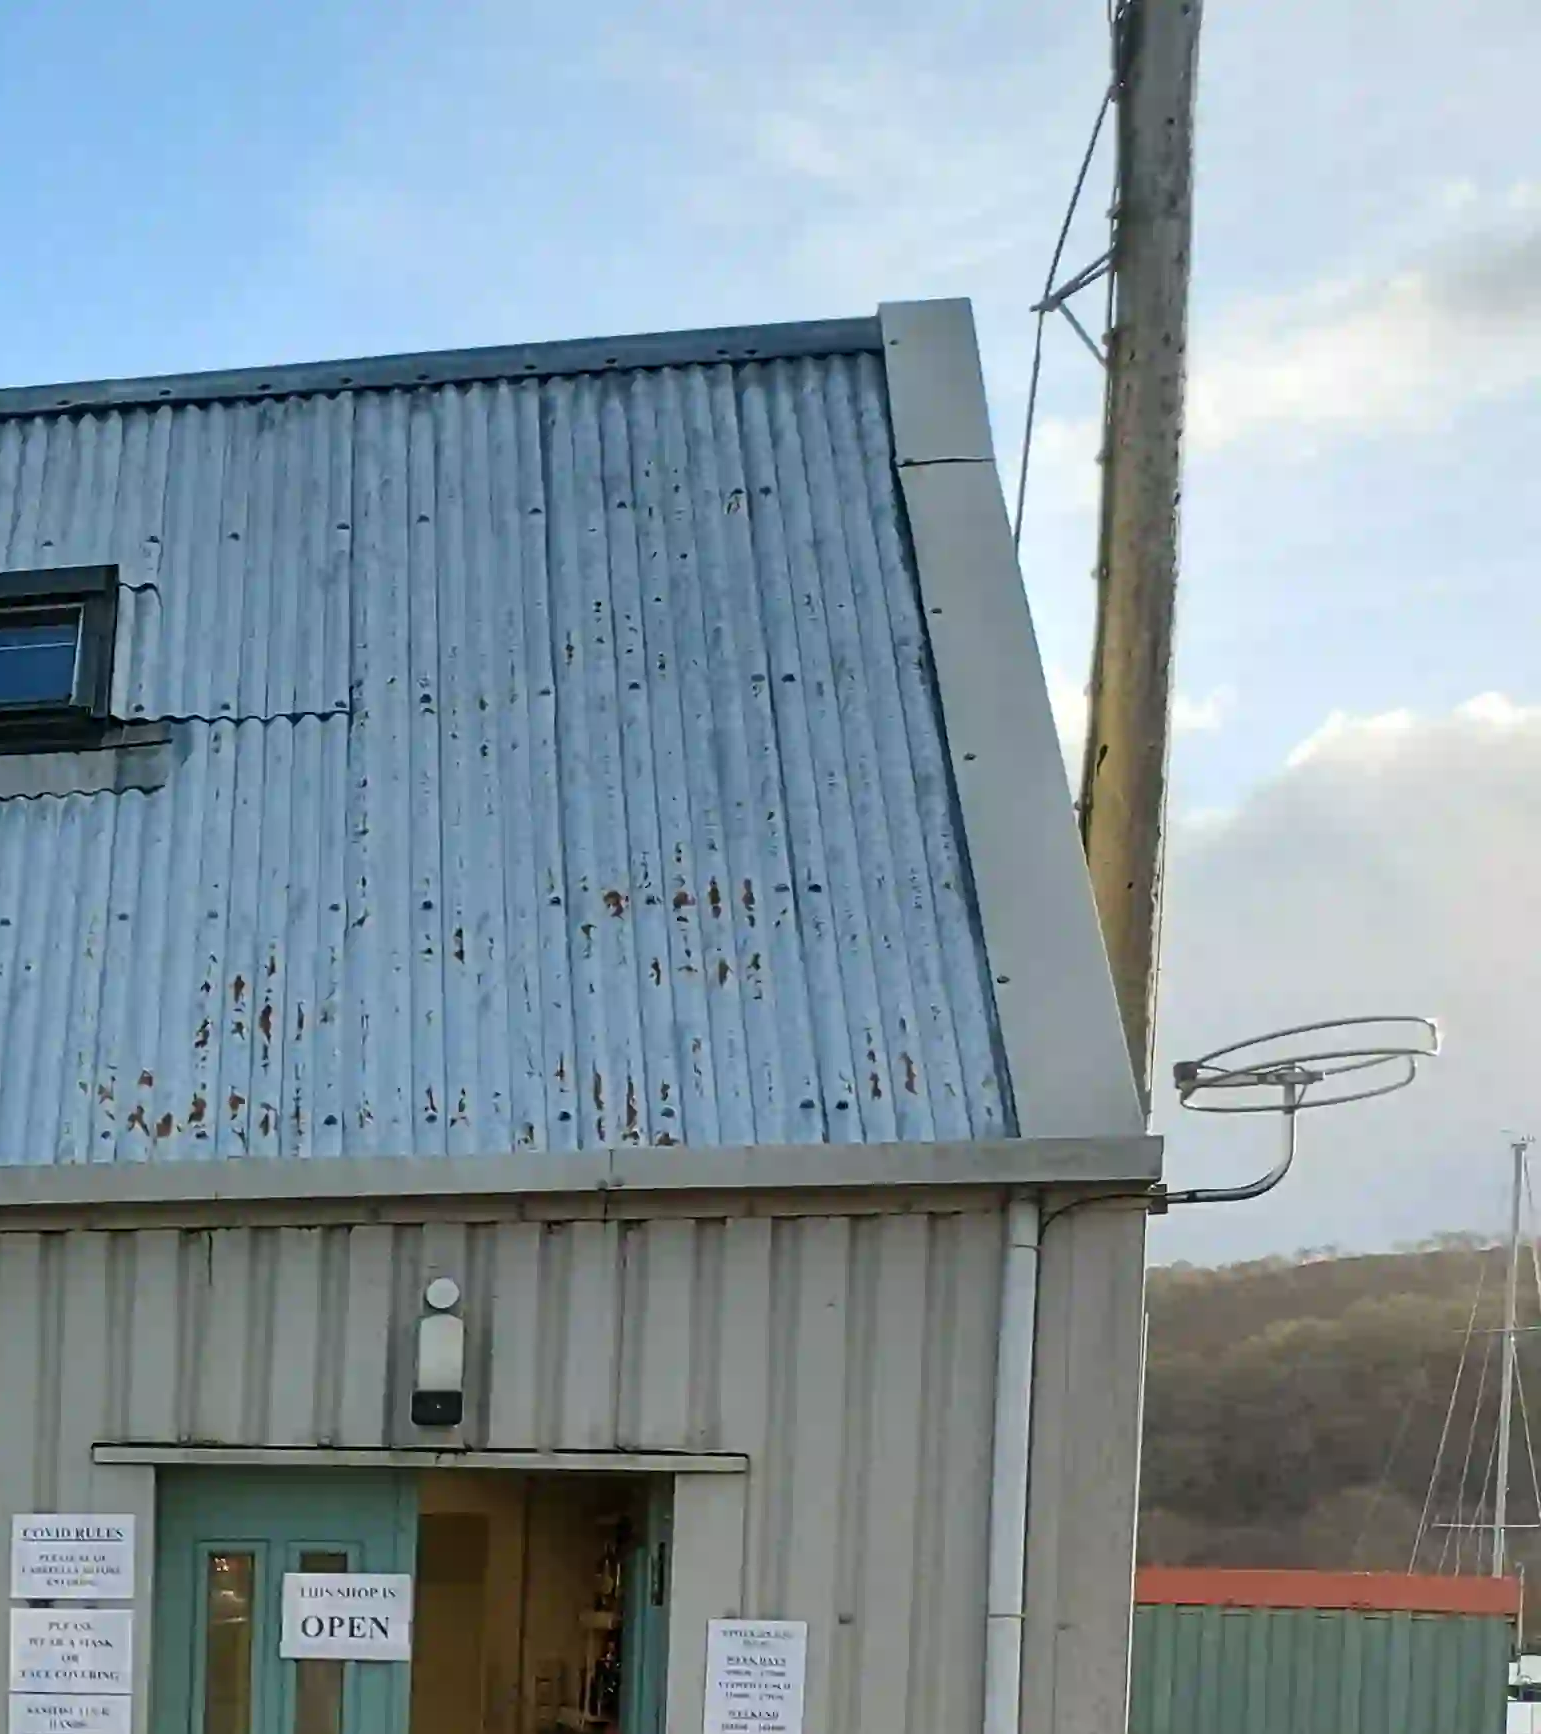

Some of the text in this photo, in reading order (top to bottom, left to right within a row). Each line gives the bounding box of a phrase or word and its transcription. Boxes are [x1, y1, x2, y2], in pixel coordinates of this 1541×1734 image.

[22, 1528, 124, 1540] COVID RULES
[300, 1587, 397, 1599] THIS SHOP IS
[301, 1614, 390, 1640] OPEN
